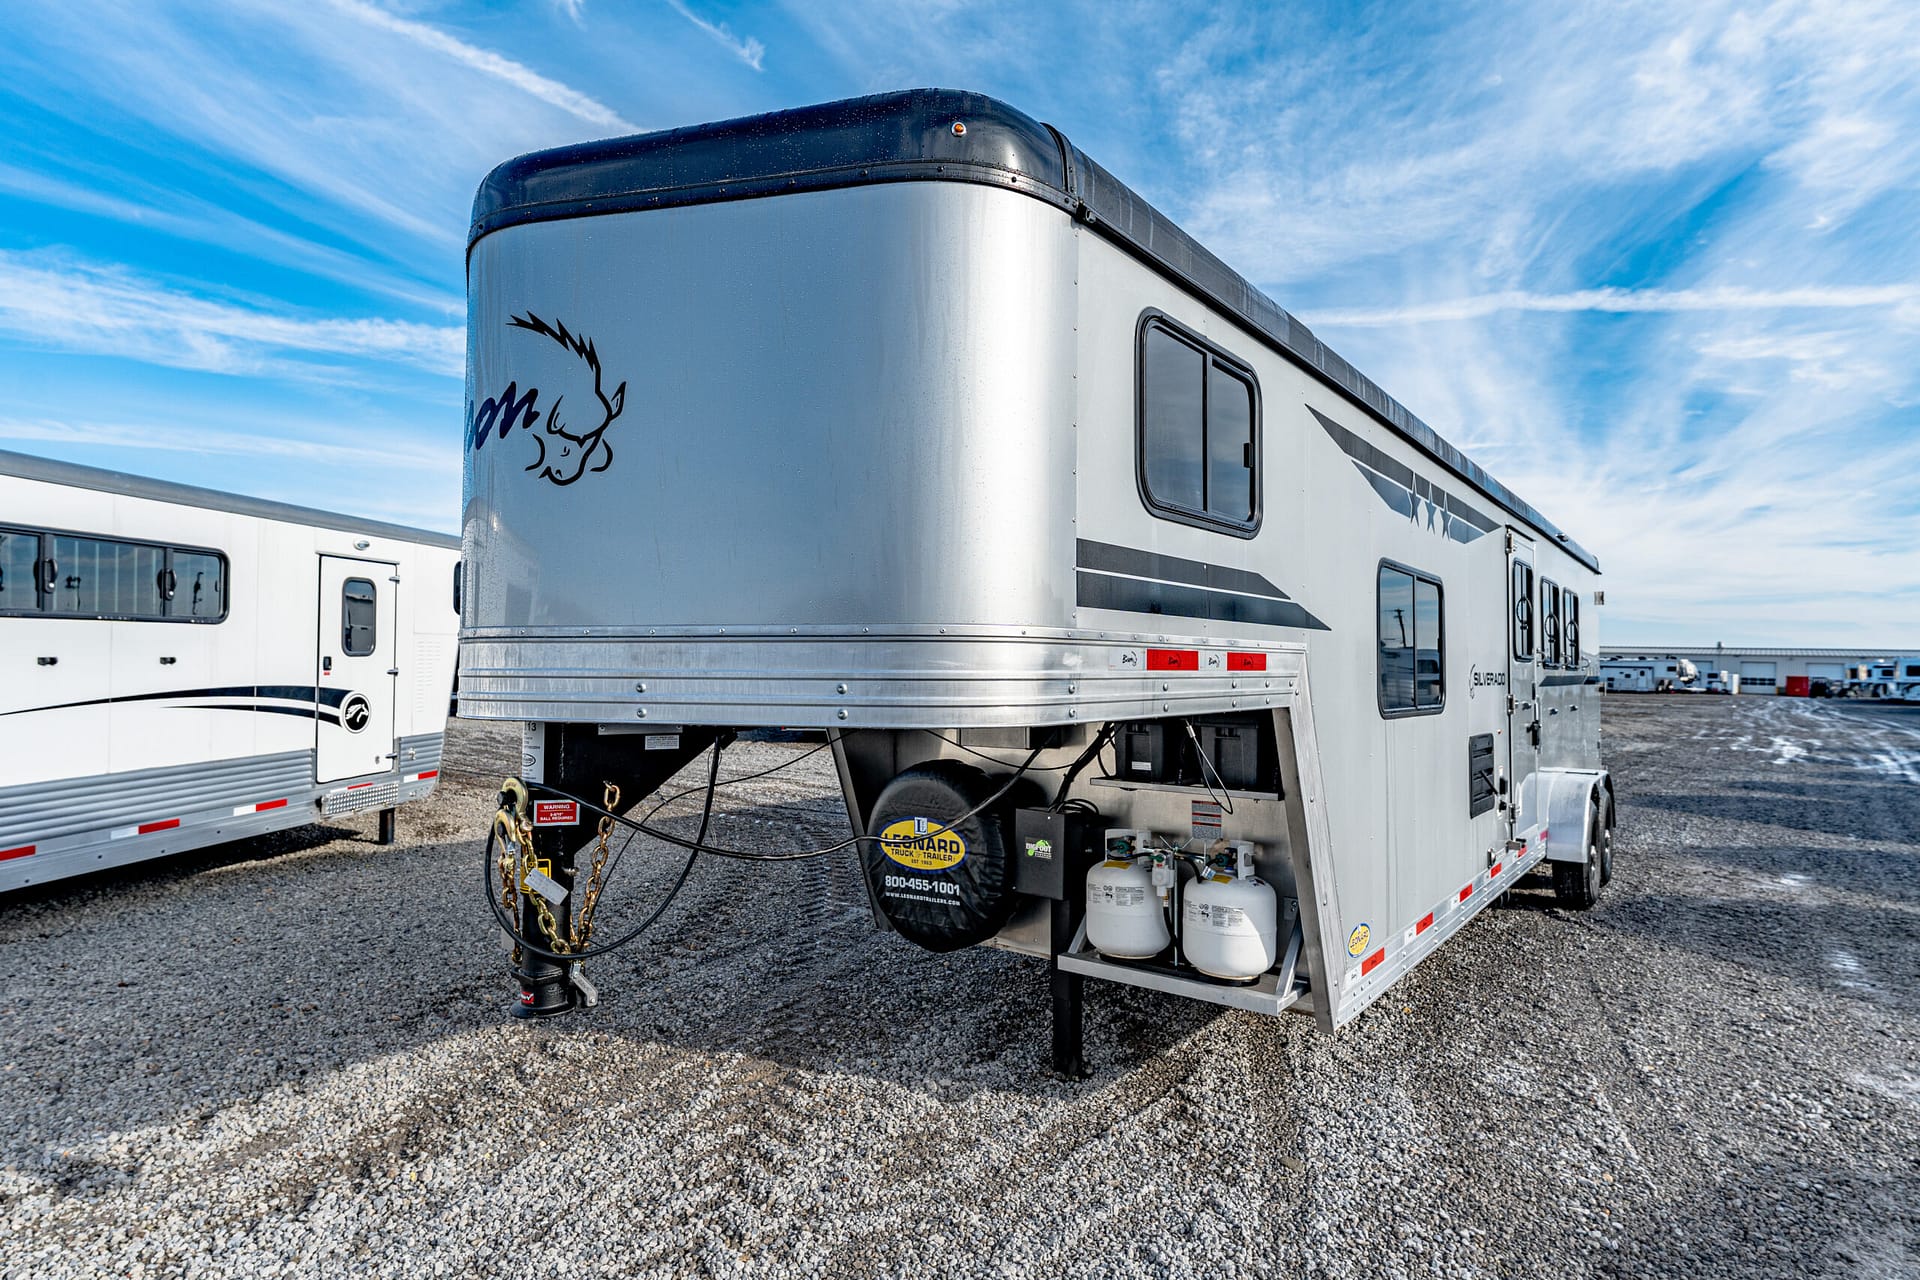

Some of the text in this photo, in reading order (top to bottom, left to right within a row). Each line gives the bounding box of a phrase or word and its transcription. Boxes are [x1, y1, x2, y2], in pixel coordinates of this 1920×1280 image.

[1473, 672, 1506, 686] SILVERADO
[884, 832, 960, 855] LEONARD
[890, 848, 914, 858] TRUCK
[922, 851, 953, 862] TRAILER
[884, 875, 961, 897] 800-455-1001
